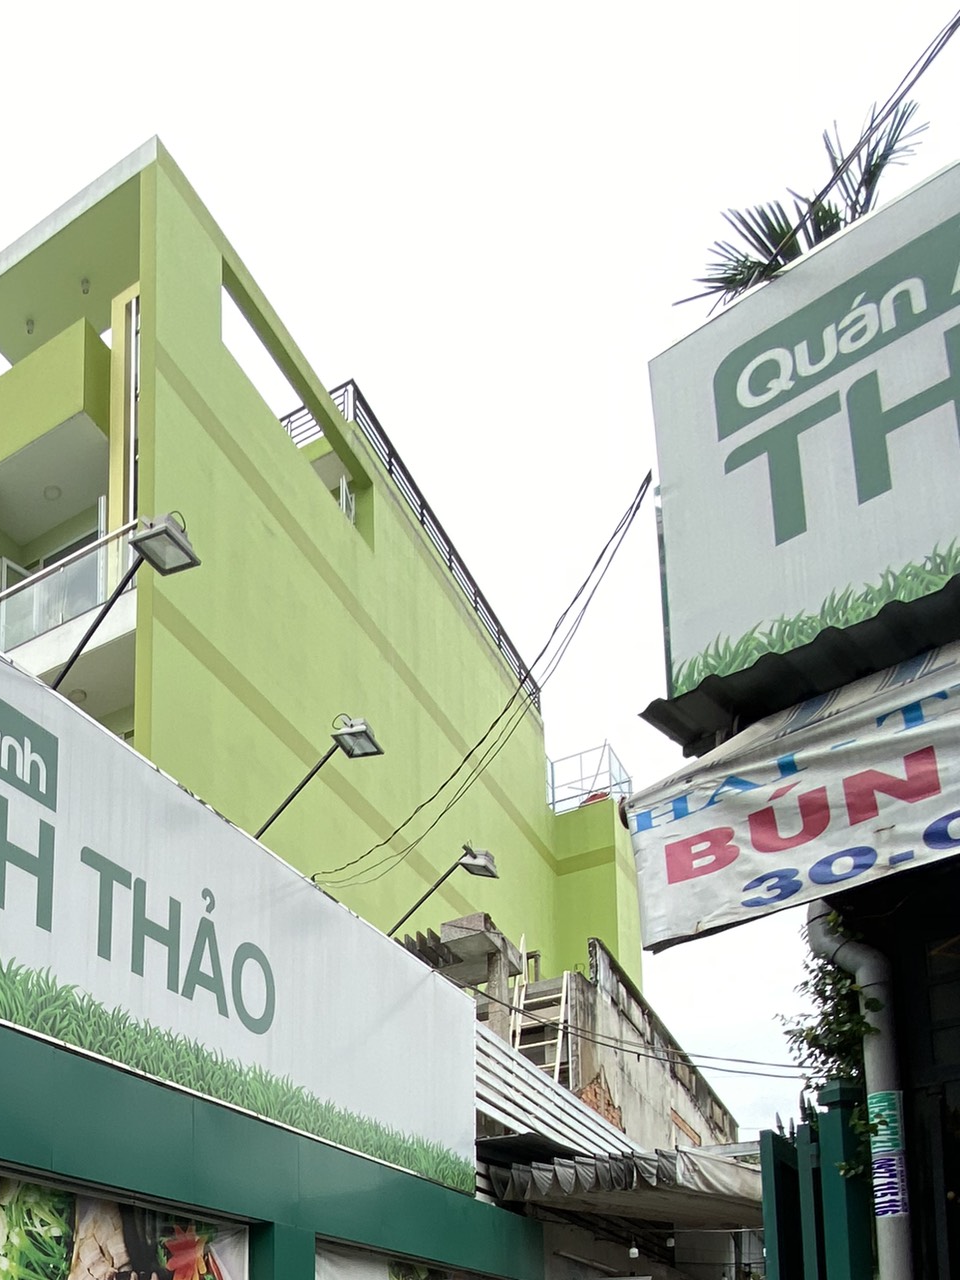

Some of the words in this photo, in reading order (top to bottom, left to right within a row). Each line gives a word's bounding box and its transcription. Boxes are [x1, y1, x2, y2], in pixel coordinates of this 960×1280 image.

[736, 277, 927, 409] Quán
[665, 745, 942, 885] BÚN
[80, 846, 276, 1036] THẢO
